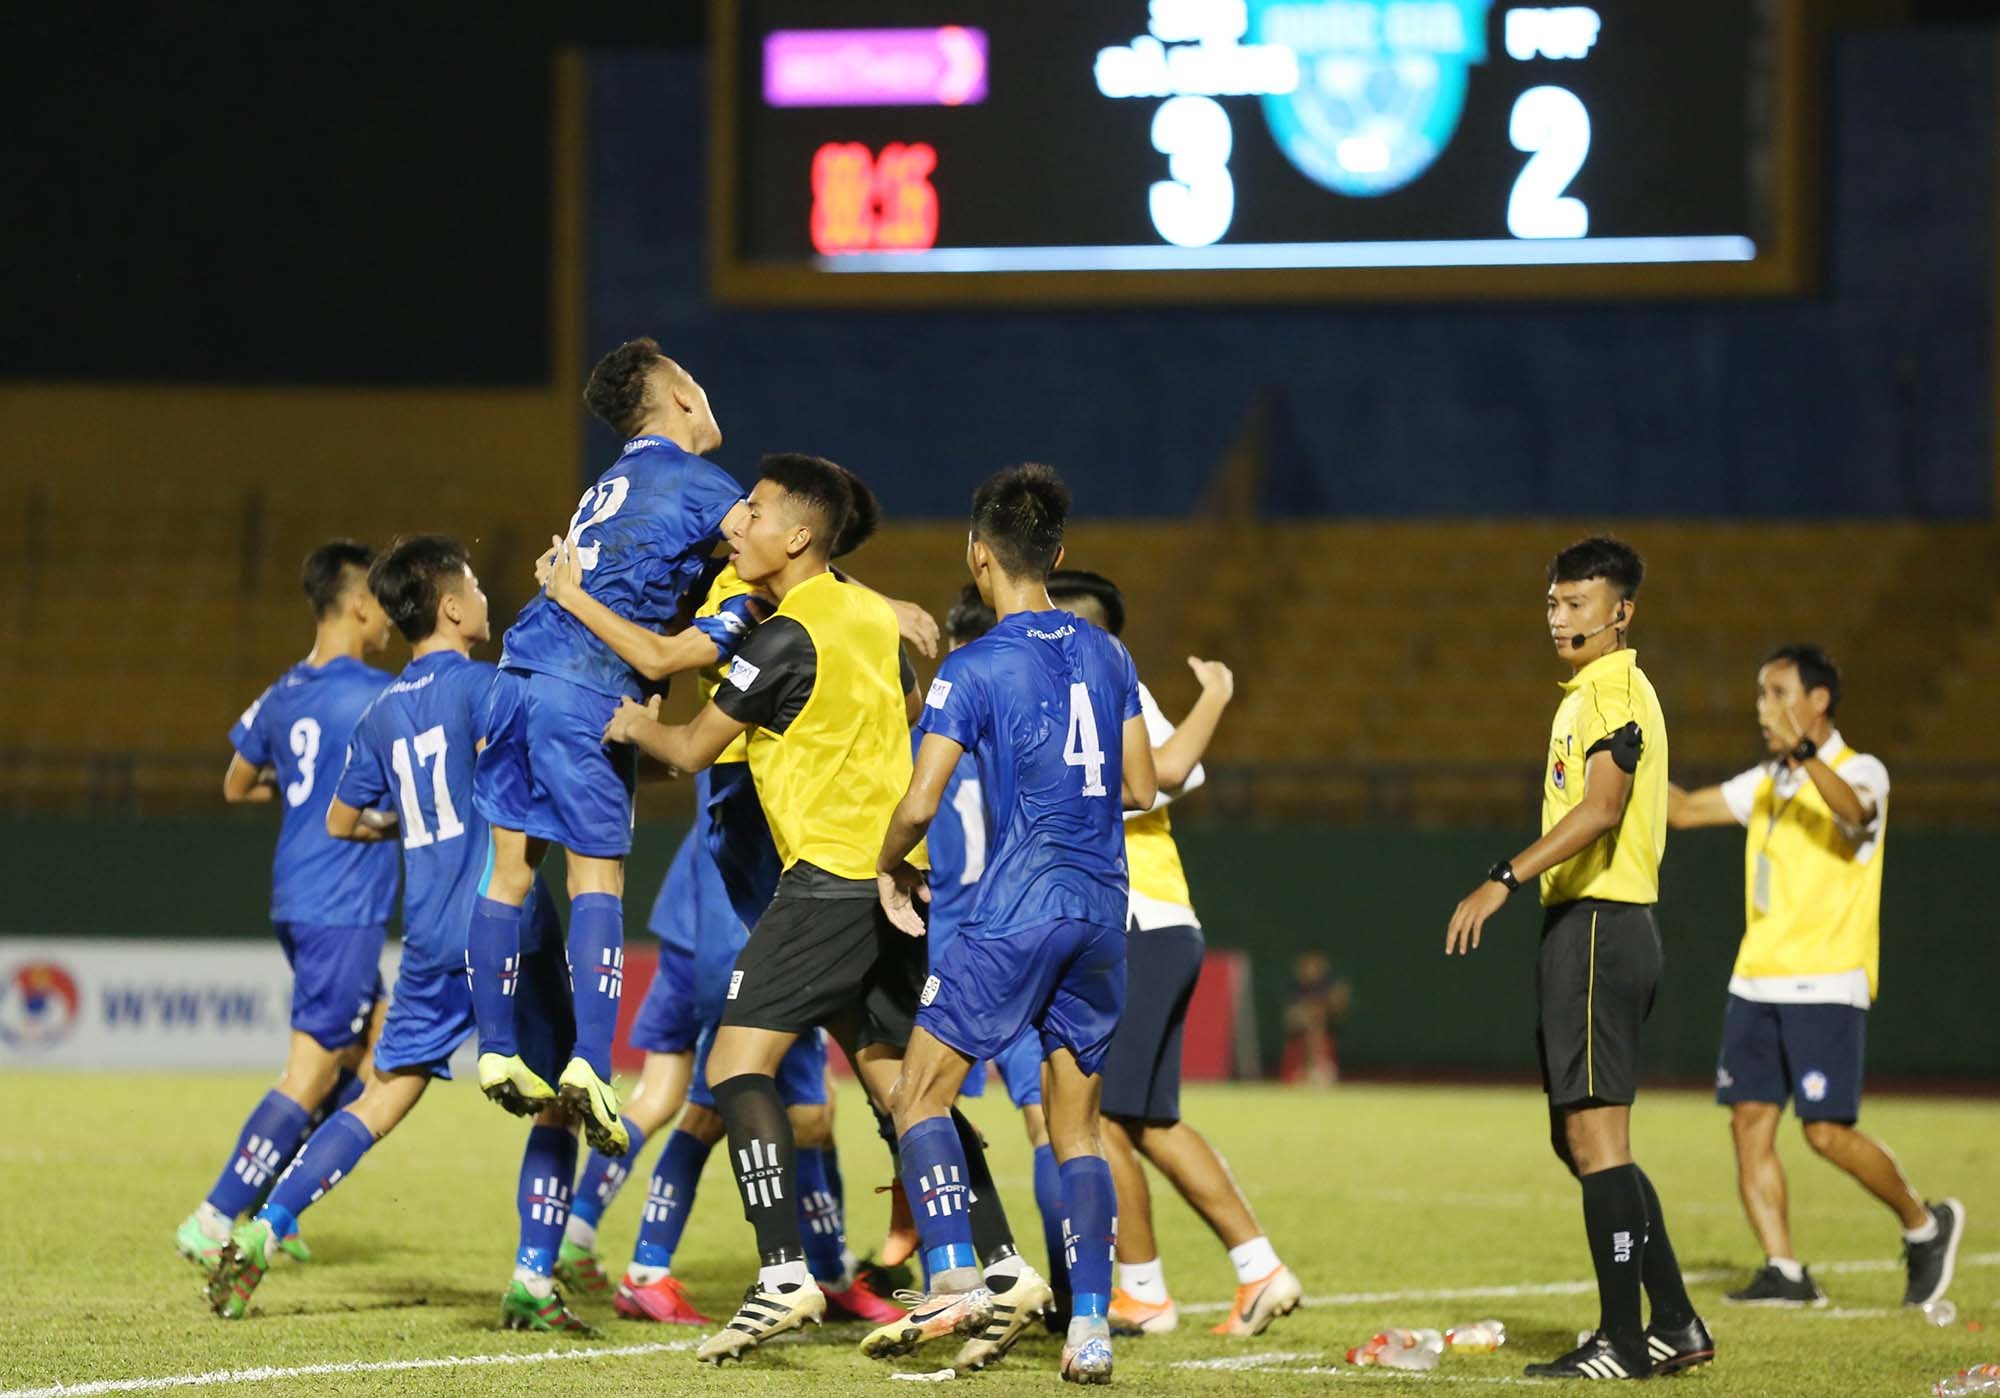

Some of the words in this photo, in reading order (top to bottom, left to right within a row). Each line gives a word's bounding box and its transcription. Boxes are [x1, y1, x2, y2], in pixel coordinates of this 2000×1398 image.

[1149, 95, 1234, 247] 3
[1507, 86, 1591, 239] 2
[287, 717, 321, 808] 3
[392, 724, 464, 850] 17
[1063, 682, 1107, 797] 4
[740, 1167, 784, 1183] SPORT
